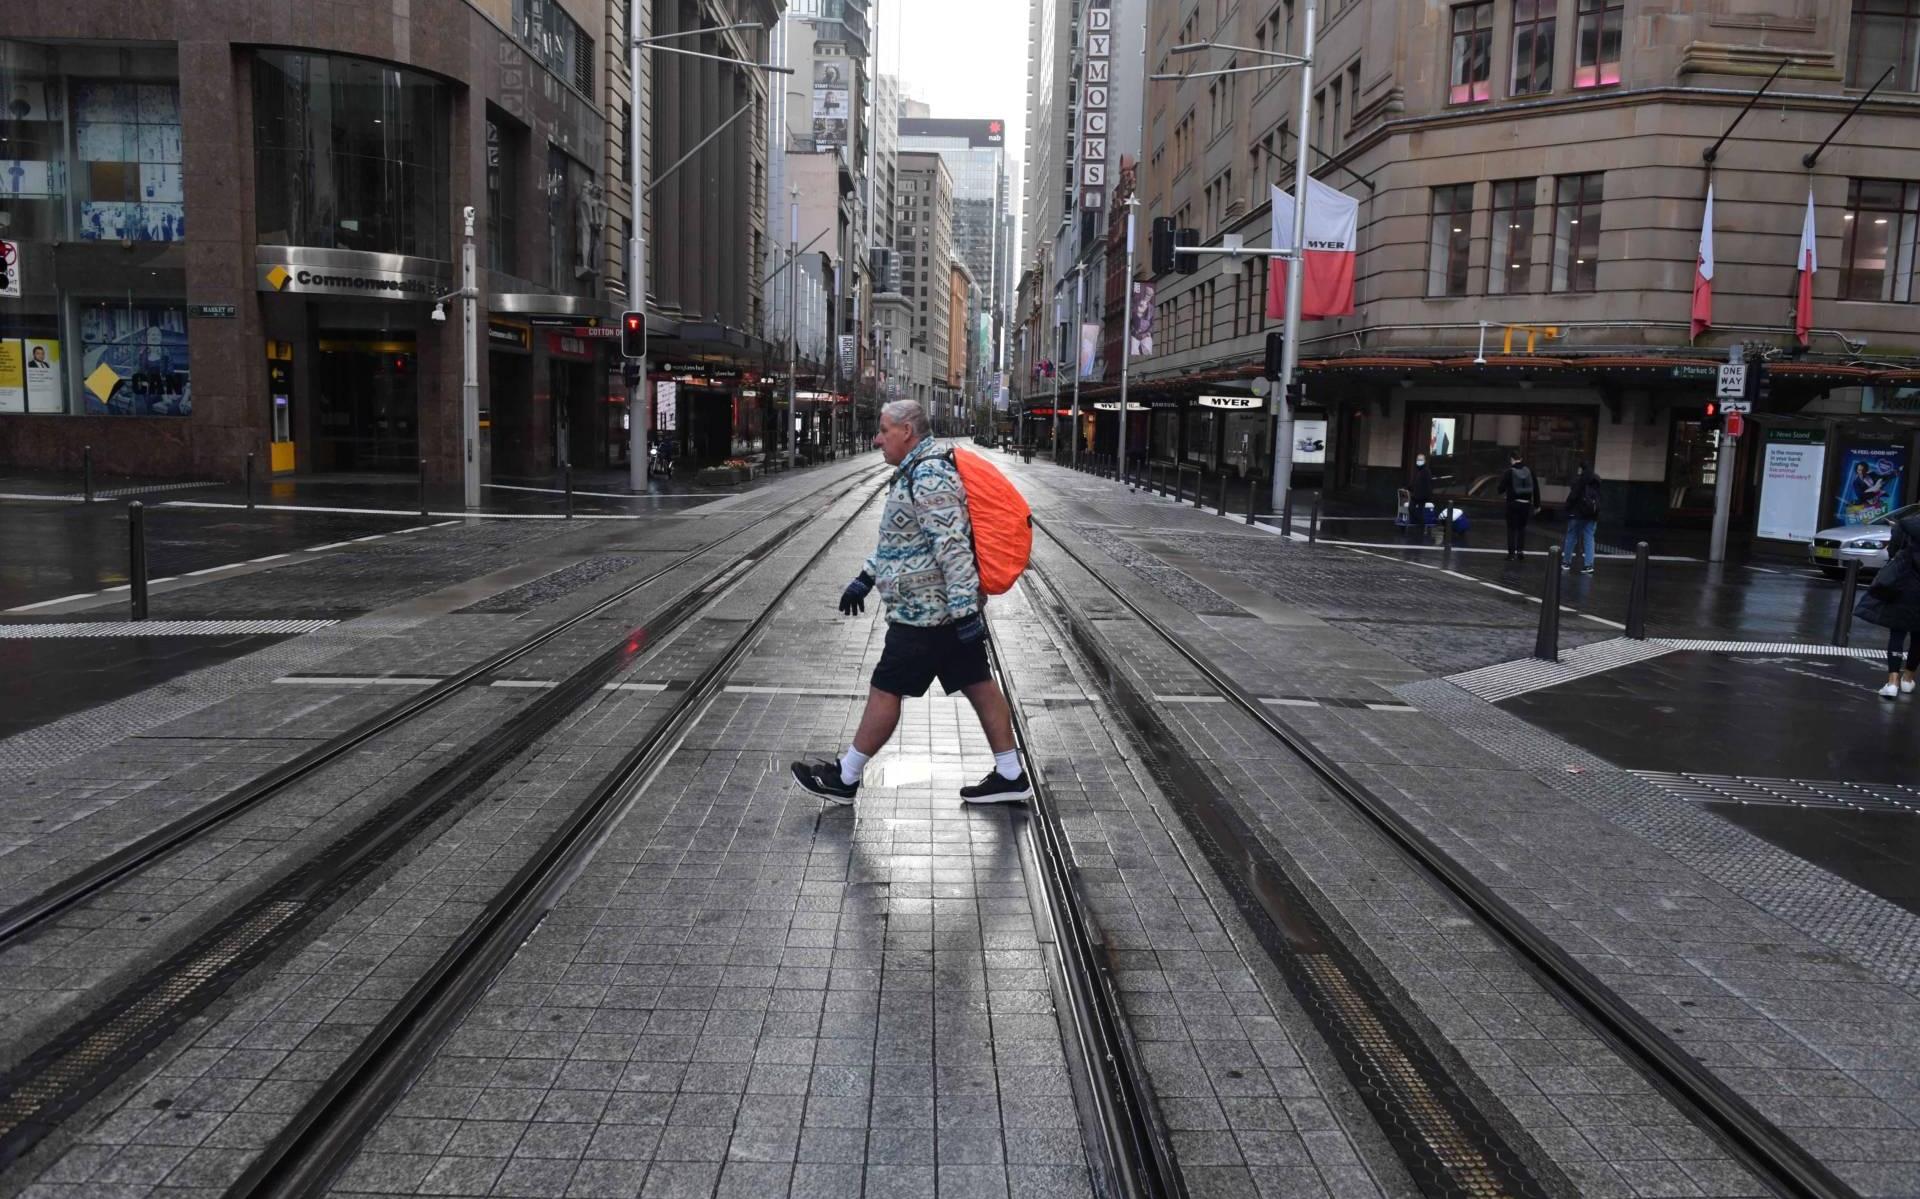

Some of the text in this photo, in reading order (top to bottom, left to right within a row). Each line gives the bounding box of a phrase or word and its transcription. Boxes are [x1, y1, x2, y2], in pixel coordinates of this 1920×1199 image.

[1088, 11, 1108, 182] DYMOCKS
[988, 134, 1002, 142] nab
[1307, 240, 1346, 249] MYER
[297, 270, 426, 294] Commonwealth
[588, 328, 614, 337] COTTON
[1682, 366, 1707, 376] Market
[1723, 367, 1742, 375] ONE
[132, 373, 183, 395] CAN
[1721, 377, 1742, 385] WAY
[1211, 398, 1250, 407] MYER
[1847, 505, 1887, 524] Singer
